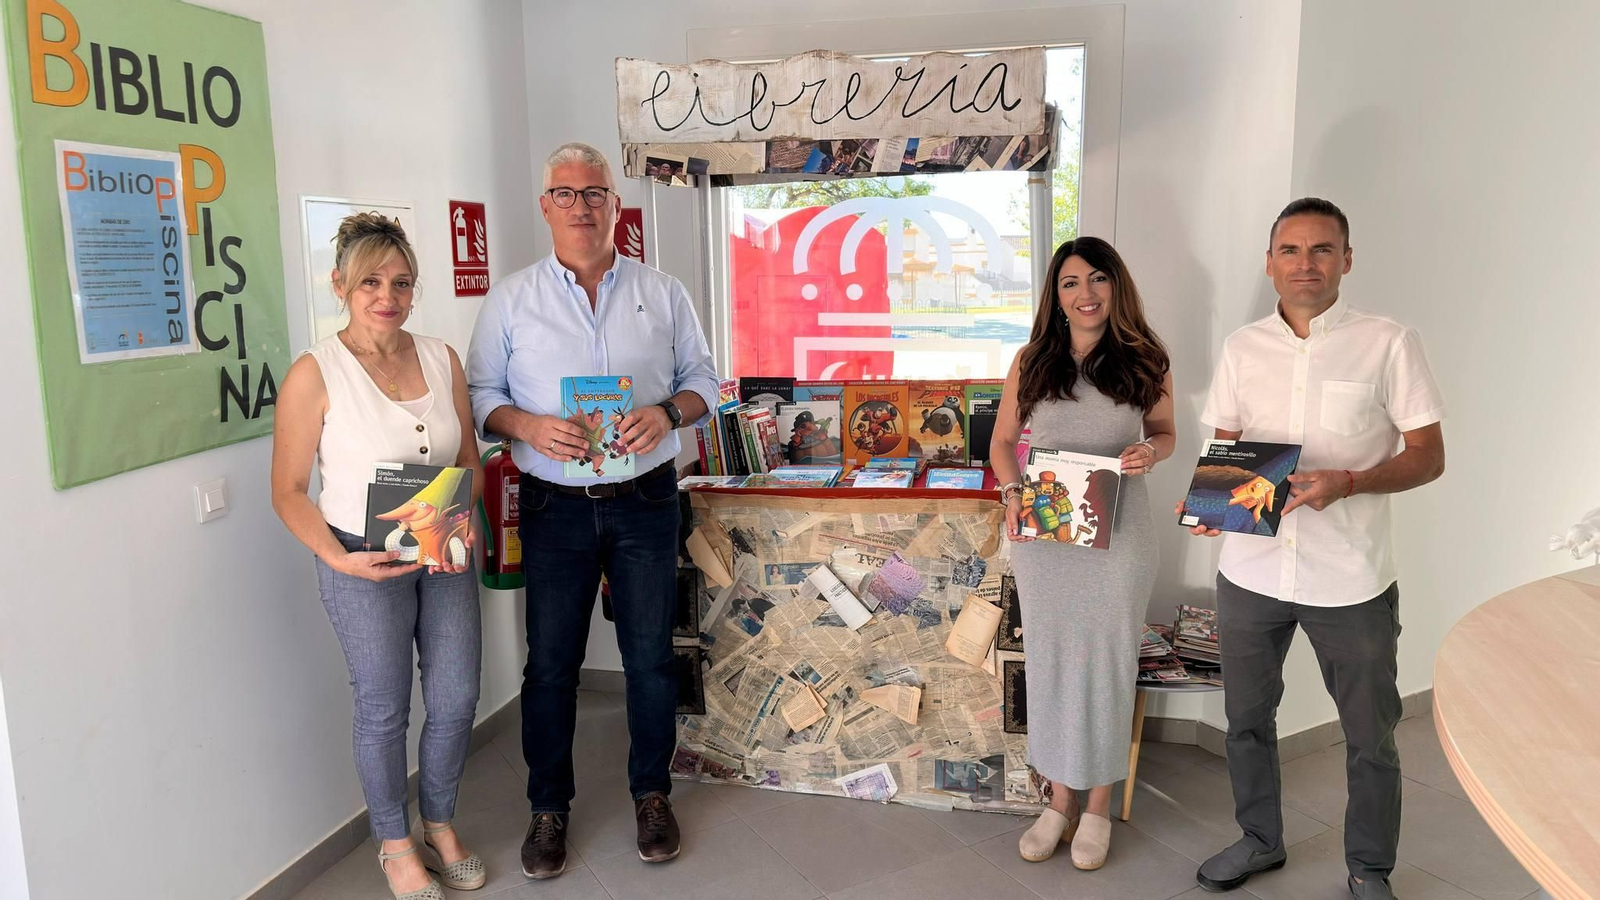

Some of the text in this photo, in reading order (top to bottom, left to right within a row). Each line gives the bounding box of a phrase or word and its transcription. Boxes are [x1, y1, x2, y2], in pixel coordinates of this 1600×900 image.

[27, 0, 241, 128] BIBLIO
[456, 275, 488, 290] EXTINTOR
[594, 393, 623, 401] LOCURAS
[856, 392, 866, 402] LOS
